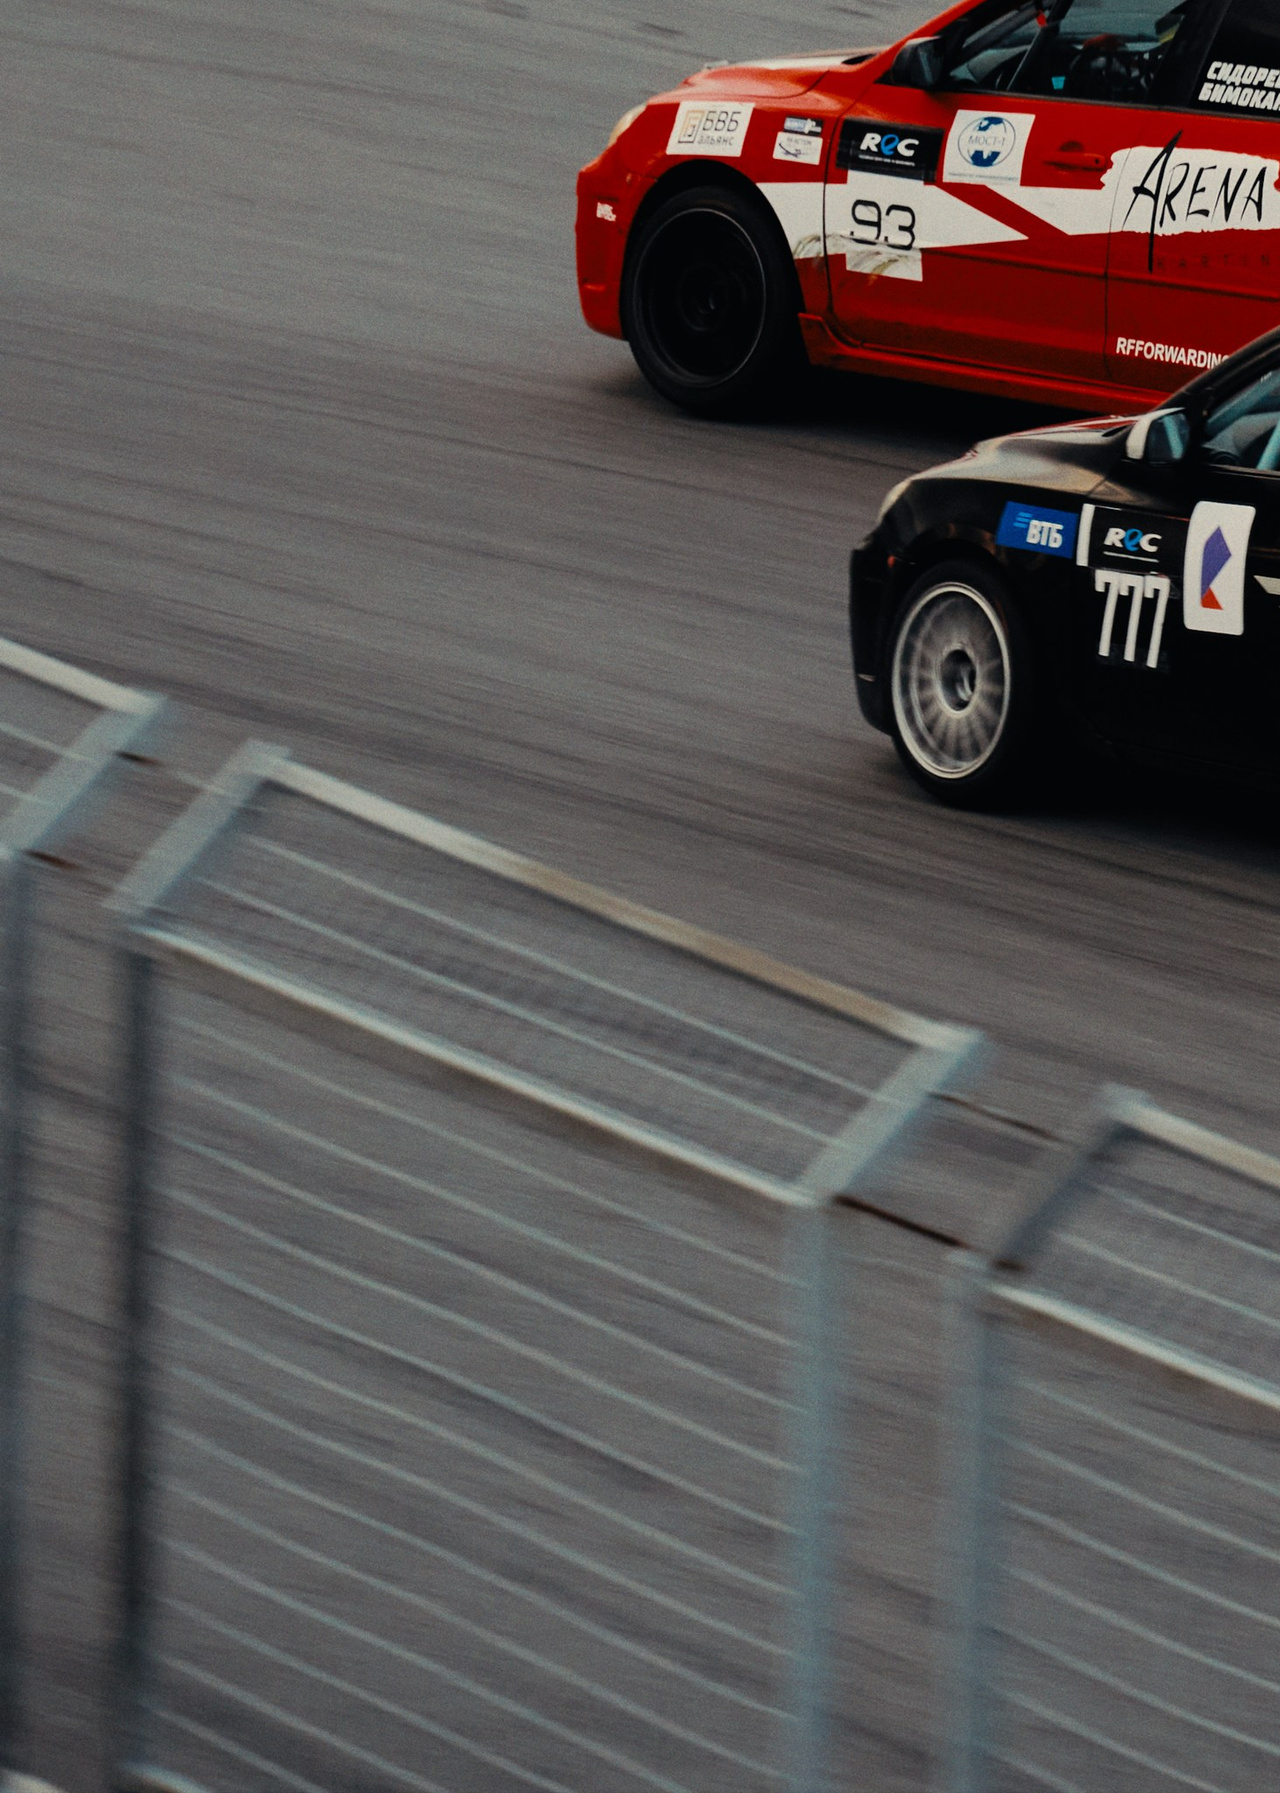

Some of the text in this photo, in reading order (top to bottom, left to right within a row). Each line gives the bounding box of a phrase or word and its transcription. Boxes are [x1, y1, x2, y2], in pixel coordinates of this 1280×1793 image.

[702, 111, 741, 132] БВБ
[1122, 129, 1268, 274] ARENA
[850, 199, 916, 251] 93
[1116, 337, 1230, 369] RFFORWARDIN
[1026, 520, 1064, 548] ВТБ
[1095, 569, 1171, 669] 777
